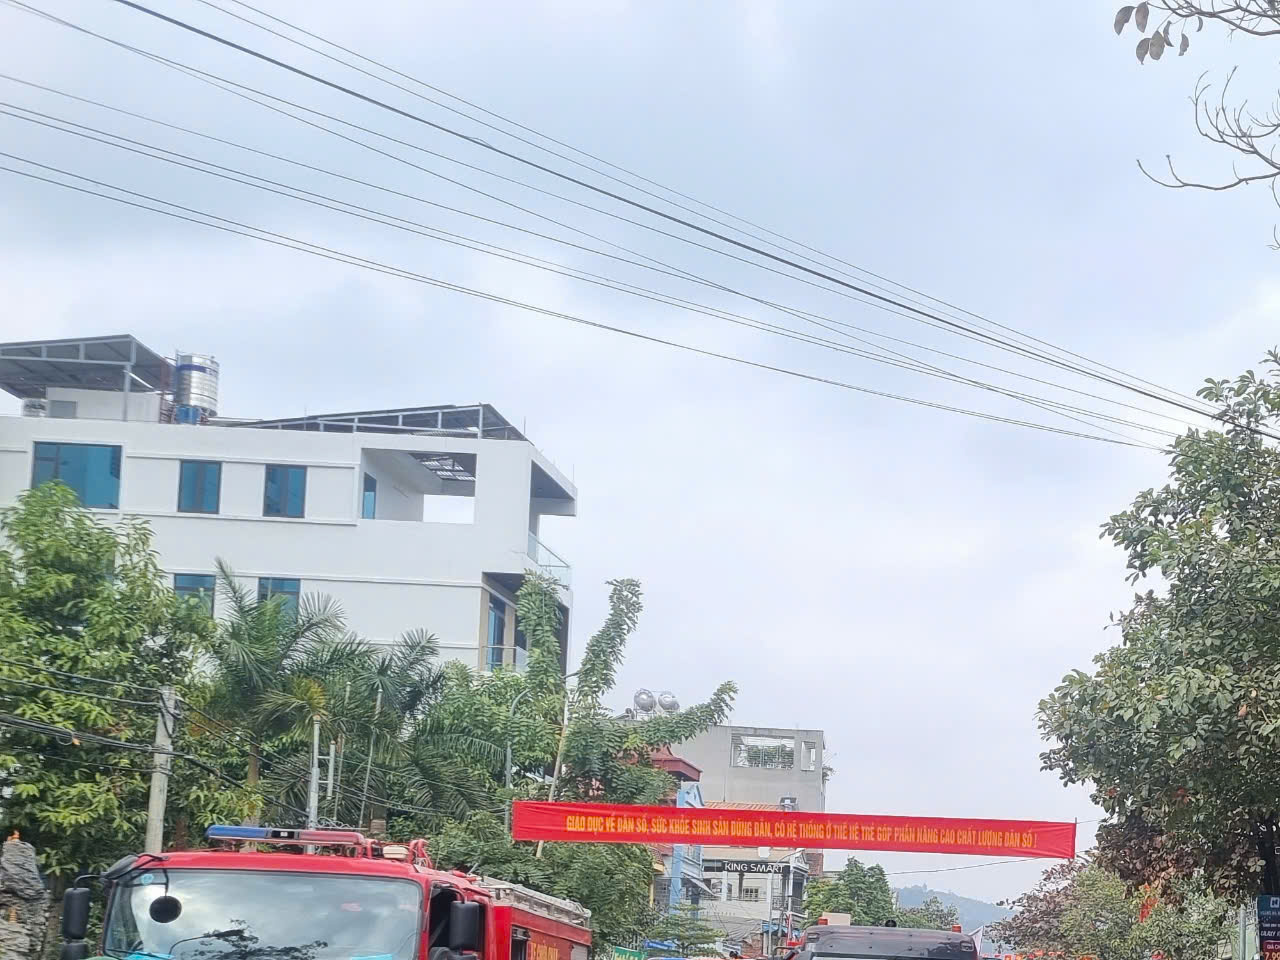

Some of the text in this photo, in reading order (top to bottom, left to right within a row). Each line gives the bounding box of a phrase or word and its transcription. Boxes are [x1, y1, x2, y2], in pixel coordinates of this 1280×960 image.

[691, 818, 711, 836] SINH
[774, 819, 785, 838] CÓ
[877, 822, 892, 841] GÓP
[940, 826, 955, 844] CAO
[725, 862, 784, 872] KING SMART
